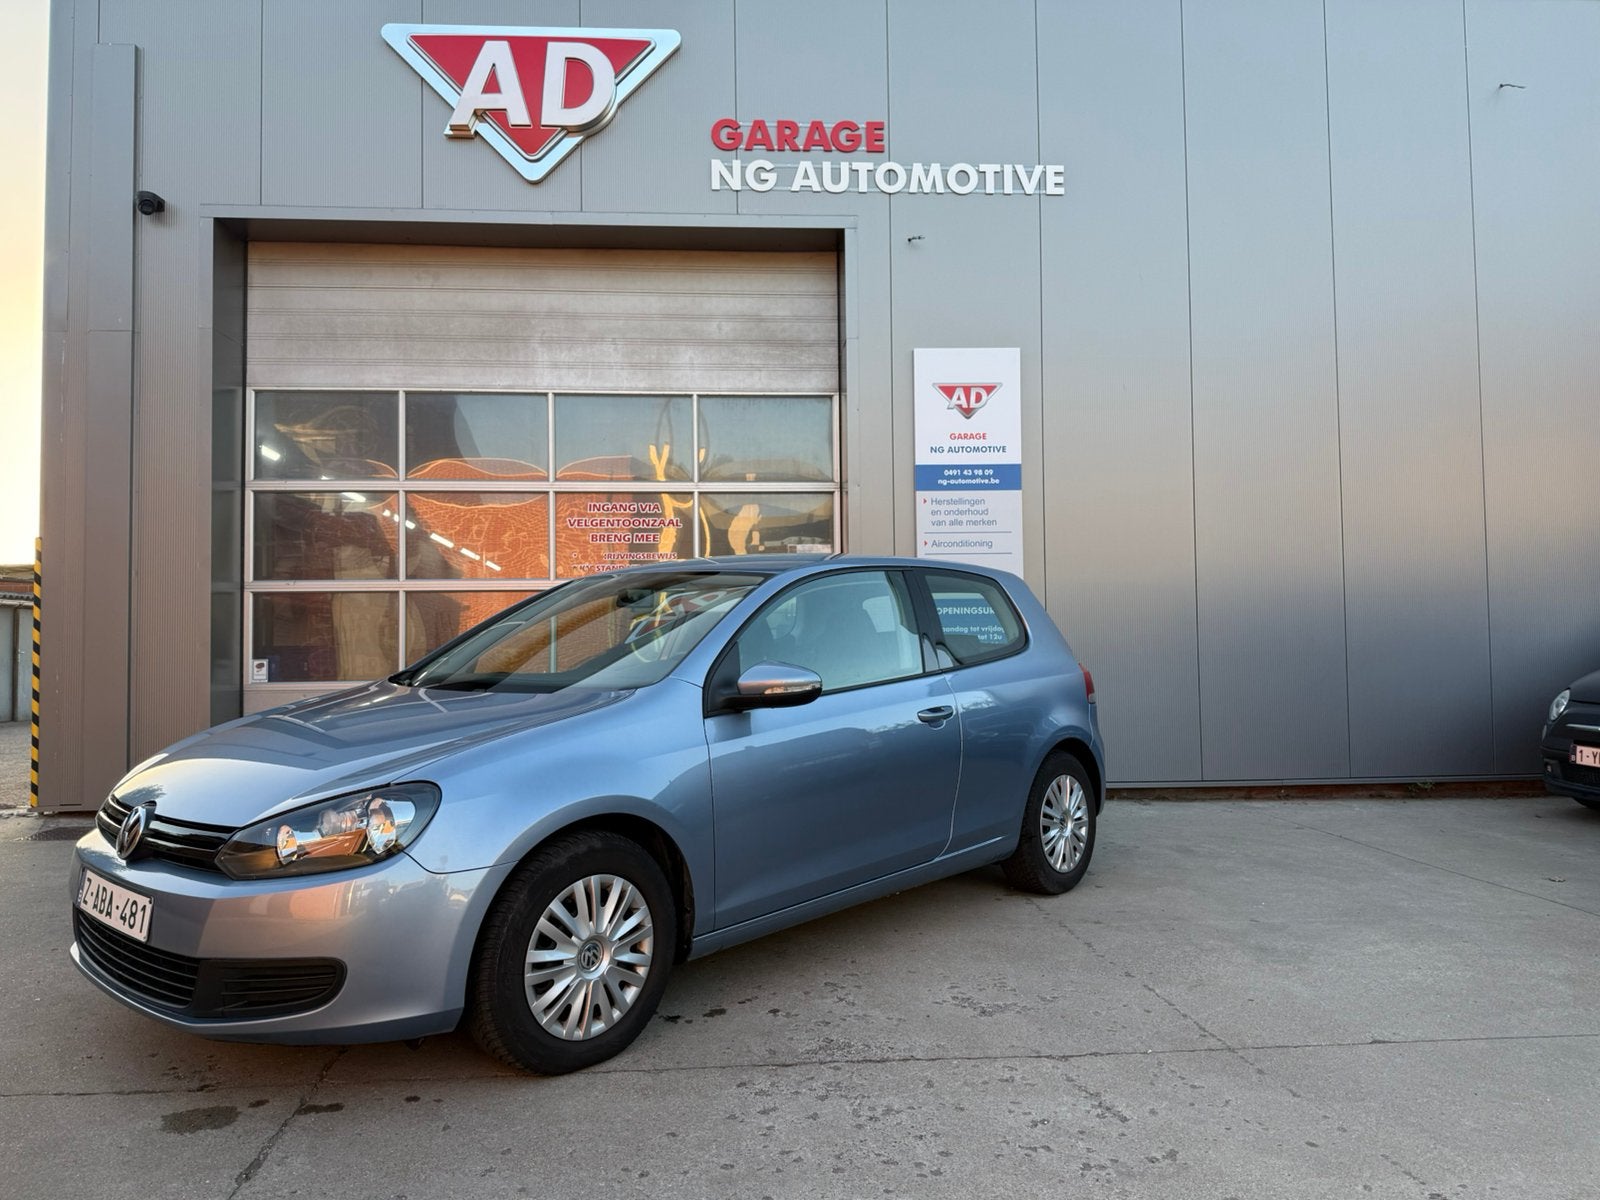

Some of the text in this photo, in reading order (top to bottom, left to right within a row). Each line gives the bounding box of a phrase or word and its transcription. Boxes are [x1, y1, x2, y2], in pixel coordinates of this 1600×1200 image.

[446, 40, 616, 130] AD
[711, 118, 885, 153] GARAGE
[711, 159, 1065, 195] NG AUTOMOTIVE
[947, 387, 988, 409] AD
[930, 446, 1007, 454] NG AUTOMOTIVE
[937, 477, 1000, 486] ng-automotive.be
[588, 503, 662, 512] INGANG VIA
[930, 498, 986, 507] Herstellingen
[944, 508, 989, 517] onderhoud
[568, 518, 682, 528] VELGENTOONZAAL
[948, 519, 964, 527] alle
[966, 518, 998, 527] merken
[590, 533, 660, 543] BRENG MEE
[931, 539, 994, 550] Airconditioning
[604, 552, 678, 560] RIJVINGSBEWIJS
[82, 877, 147, 933] Z-ABA-481
